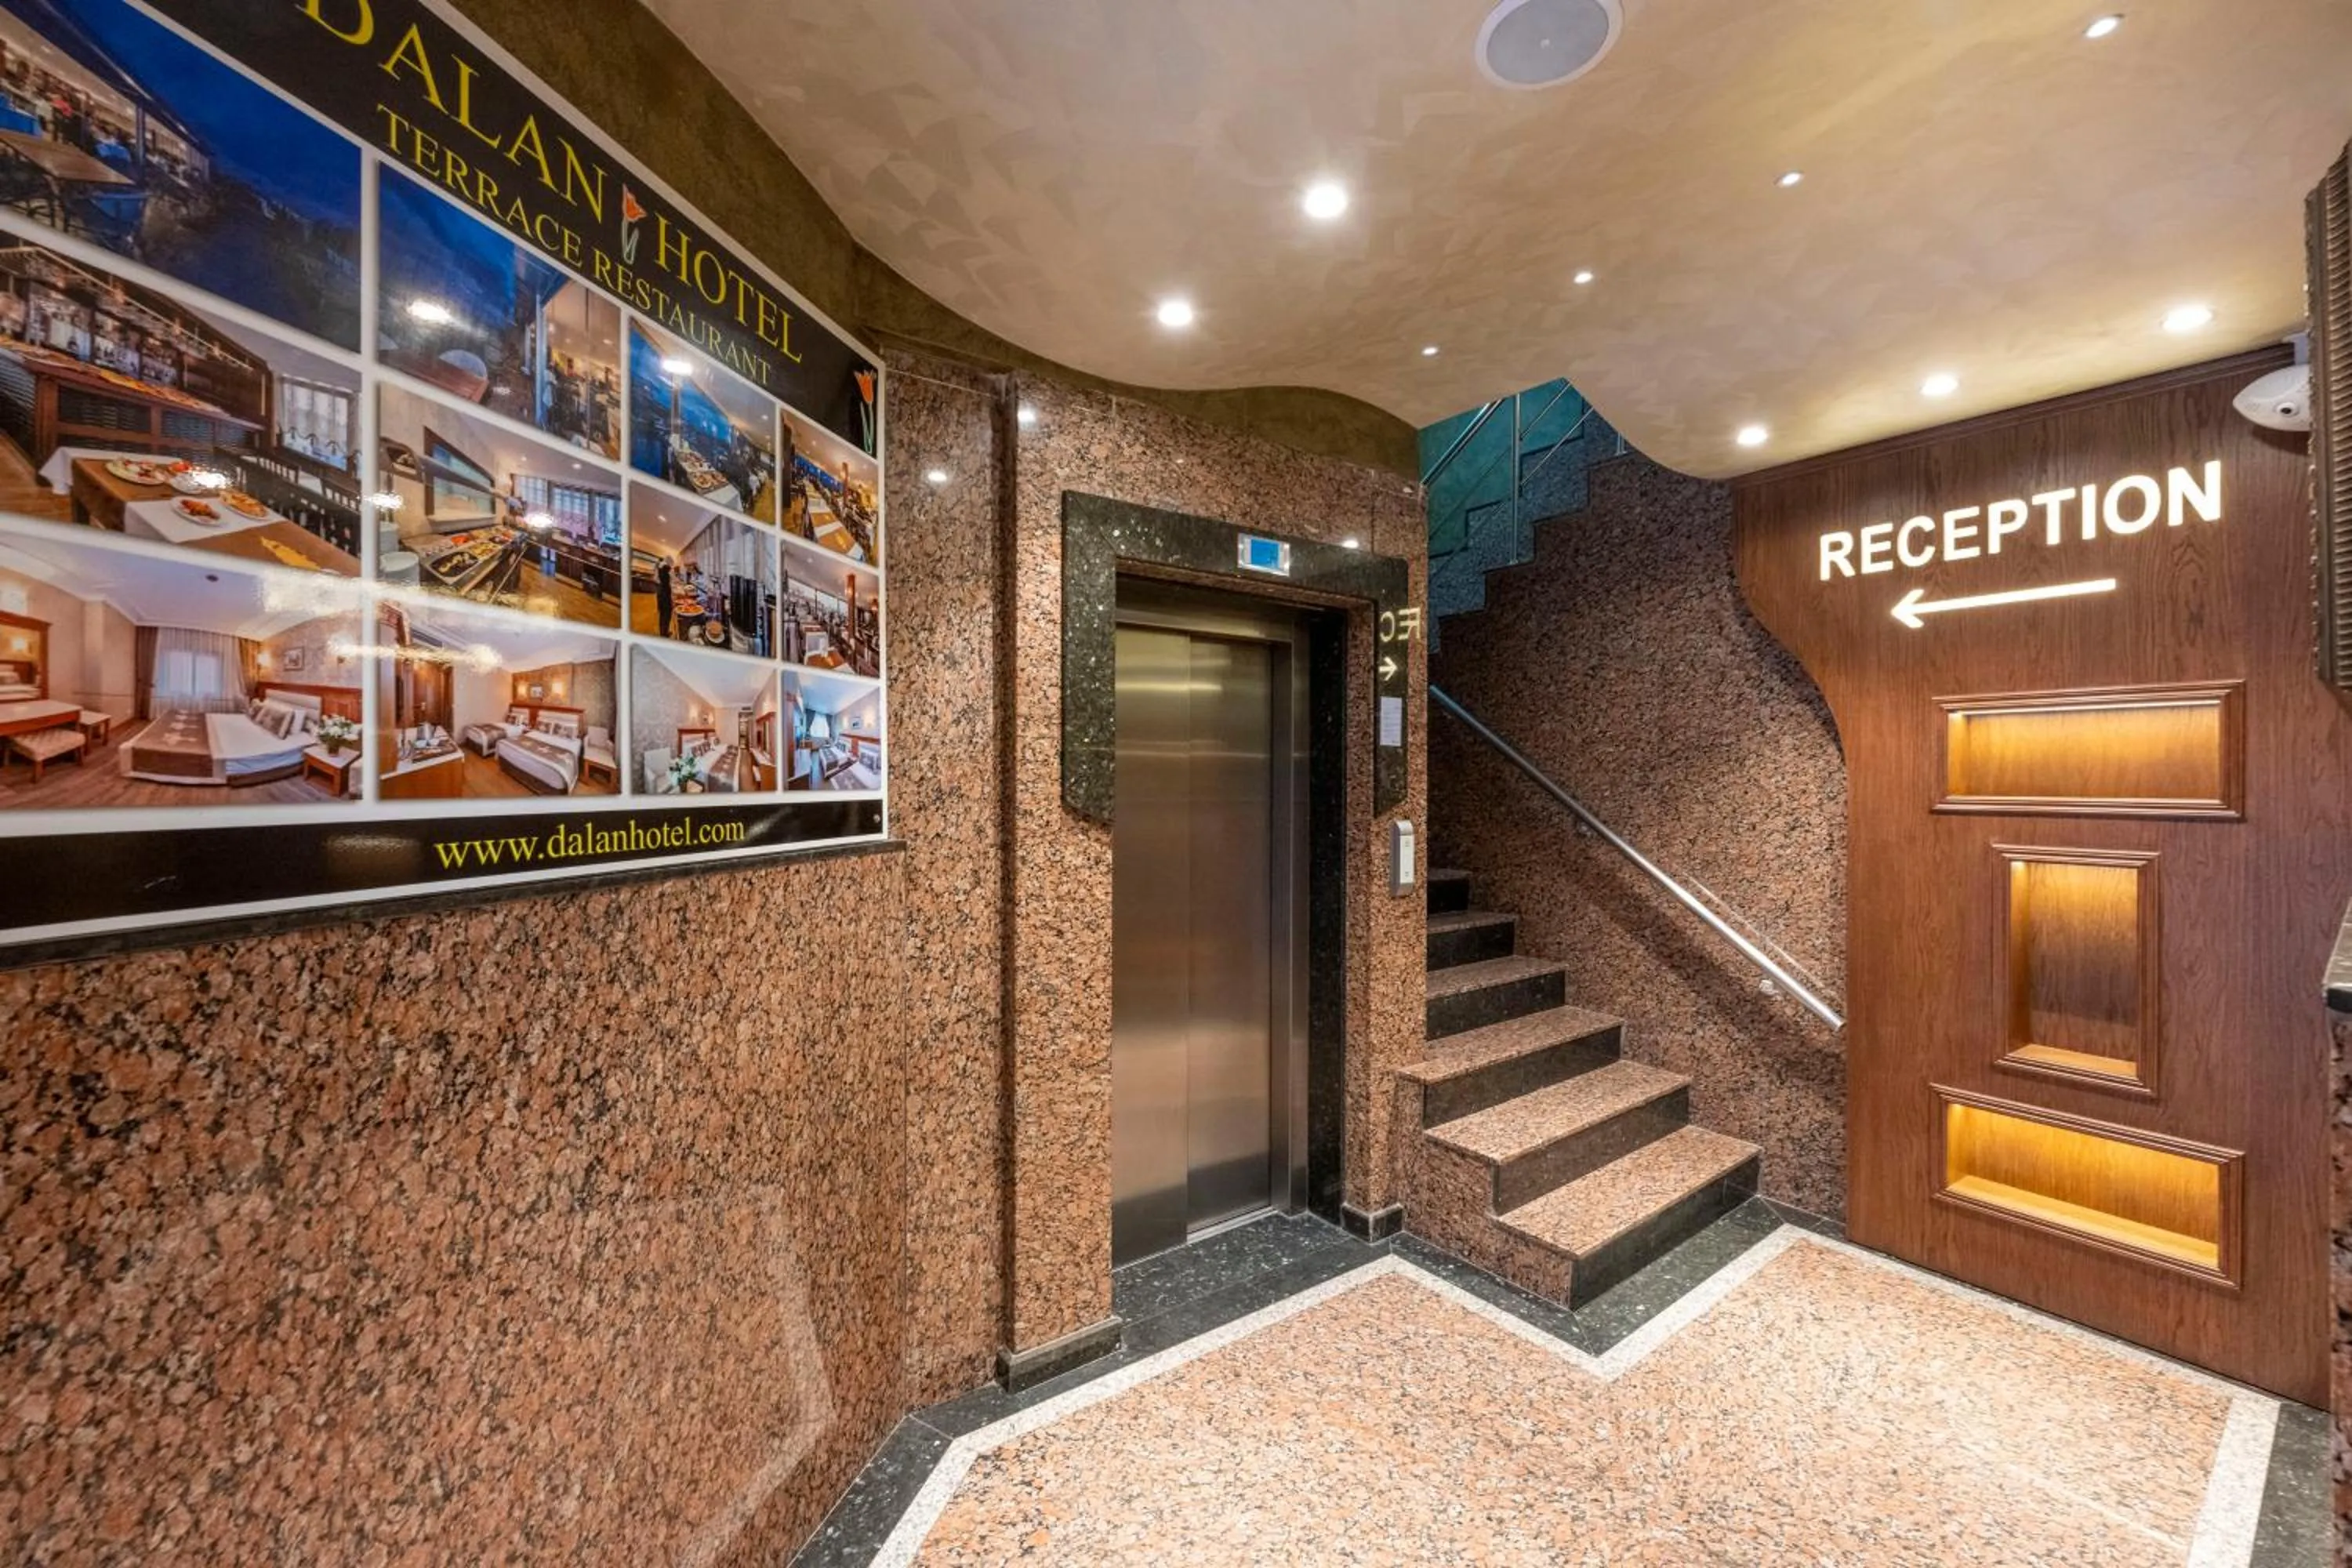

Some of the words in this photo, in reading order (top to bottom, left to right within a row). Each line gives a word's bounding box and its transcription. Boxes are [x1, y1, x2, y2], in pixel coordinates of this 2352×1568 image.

[378, 103, 583, 263] TERRACE
[593, 249, 771, 385] RESTAURANT
[655, 212, 802, 363] HOTEL
[1819, 460, 2222, 582] RECEPTION
[435, 817, 746, 869] www.dalanhotel.com
